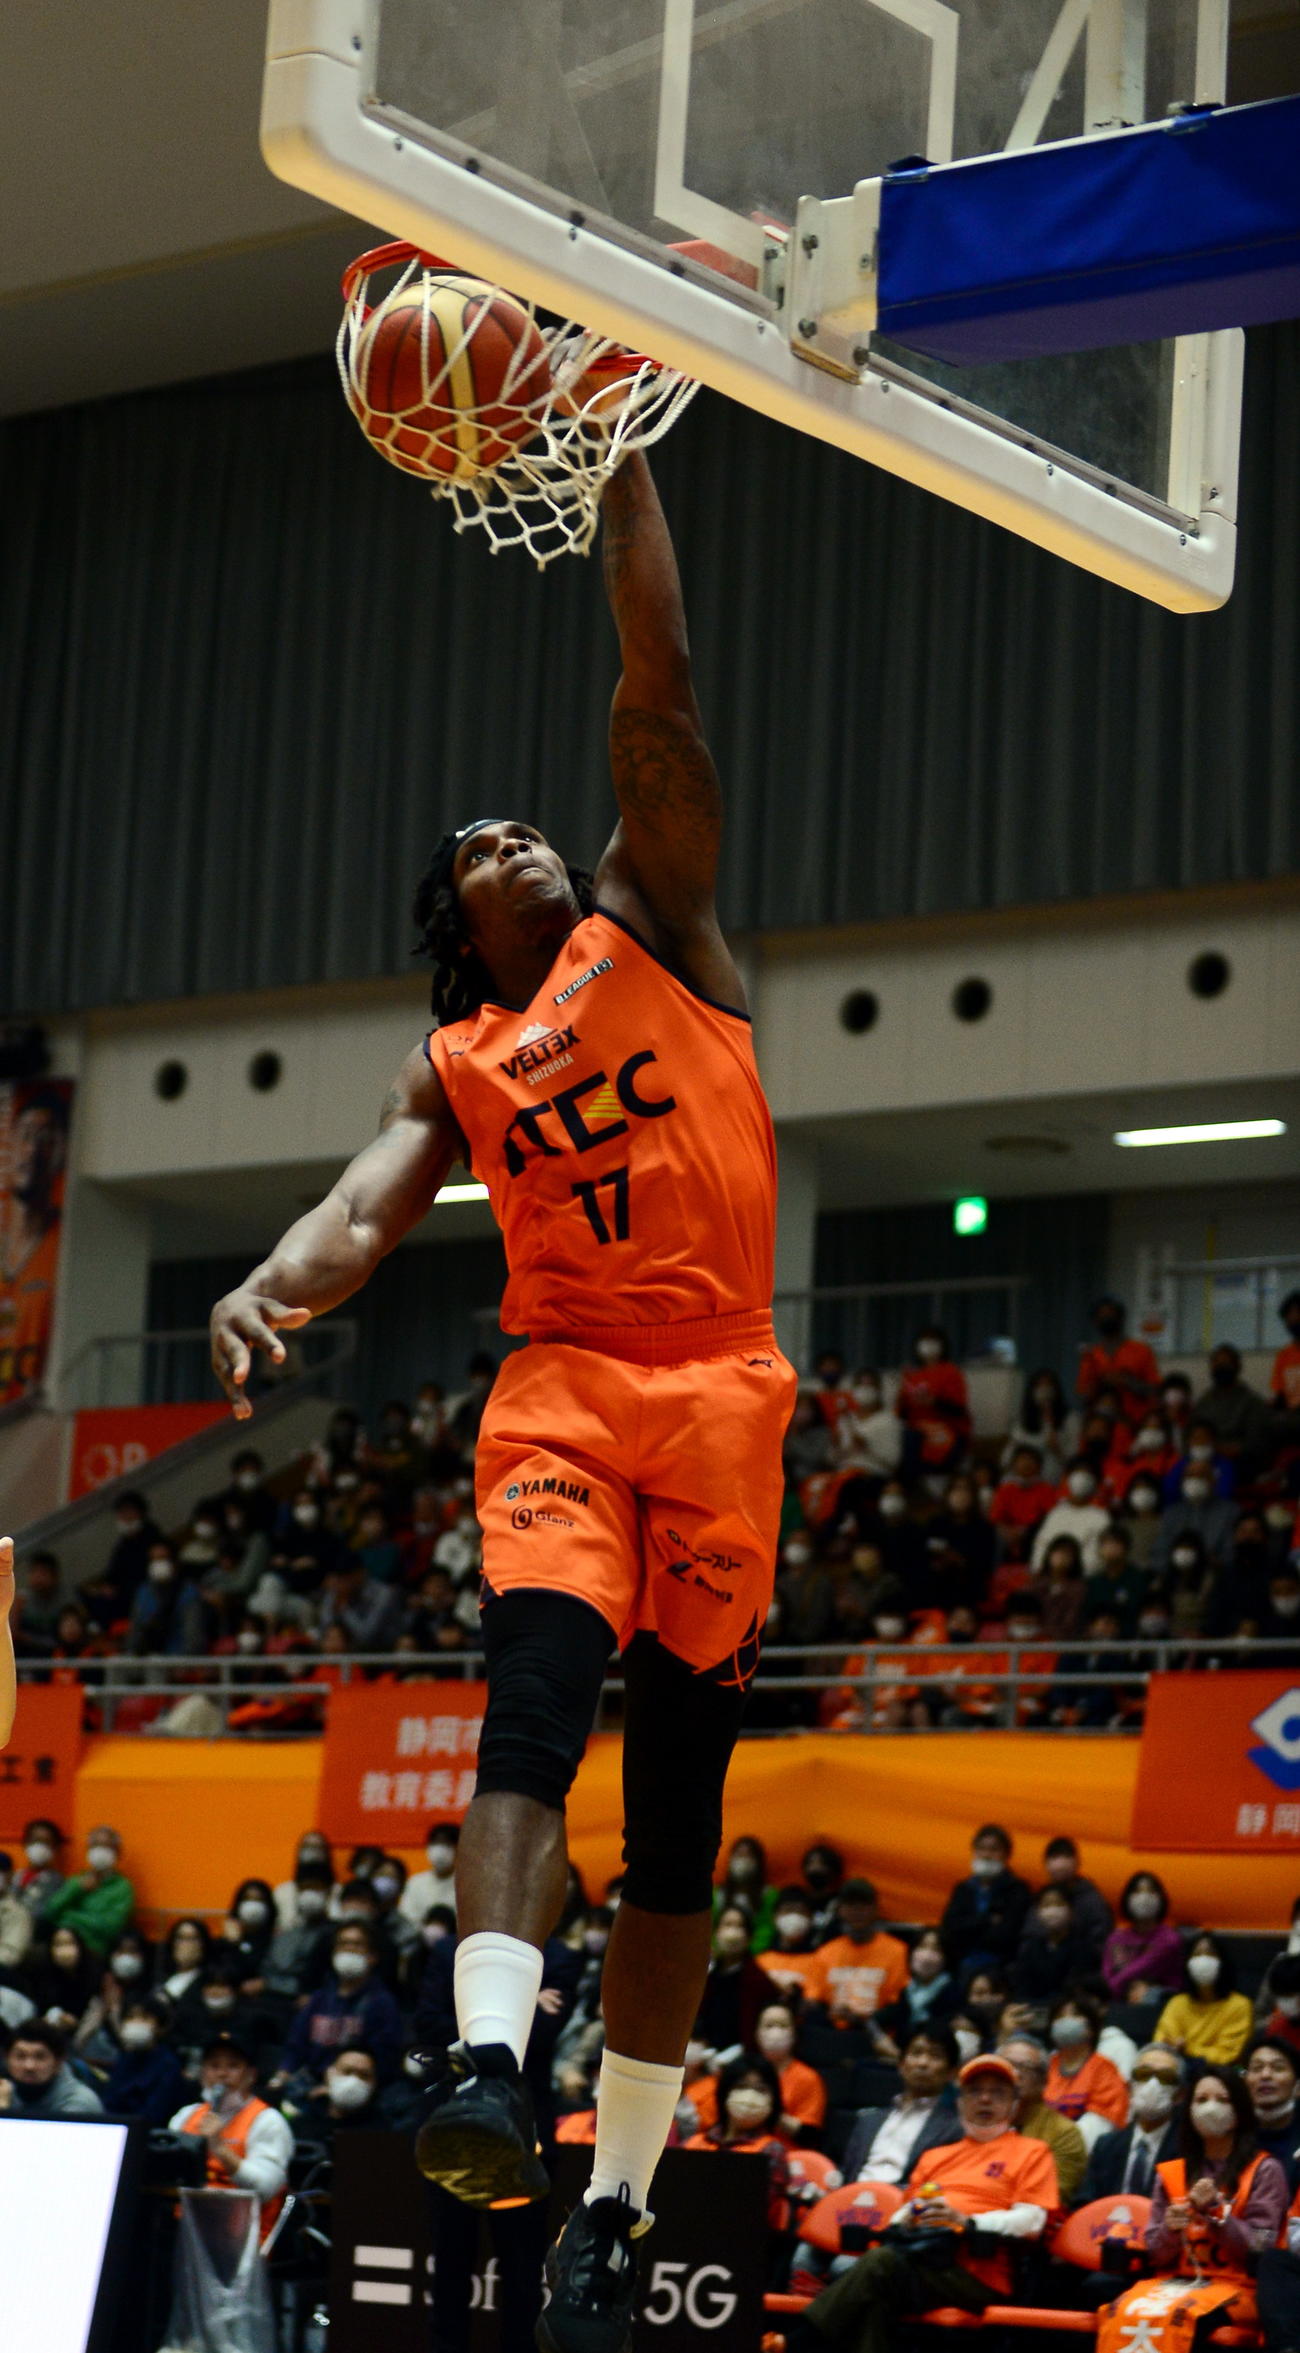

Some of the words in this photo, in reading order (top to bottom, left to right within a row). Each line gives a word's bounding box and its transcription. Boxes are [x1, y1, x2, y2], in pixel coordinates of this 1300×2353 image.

[526, 1053, 574, 1086] SHIZUOKA
[571, 1165, 630, 1245] 17
[522, 1478, 589, 1506] YAMAHA
[643, 2261, 738, 2329] 5G
